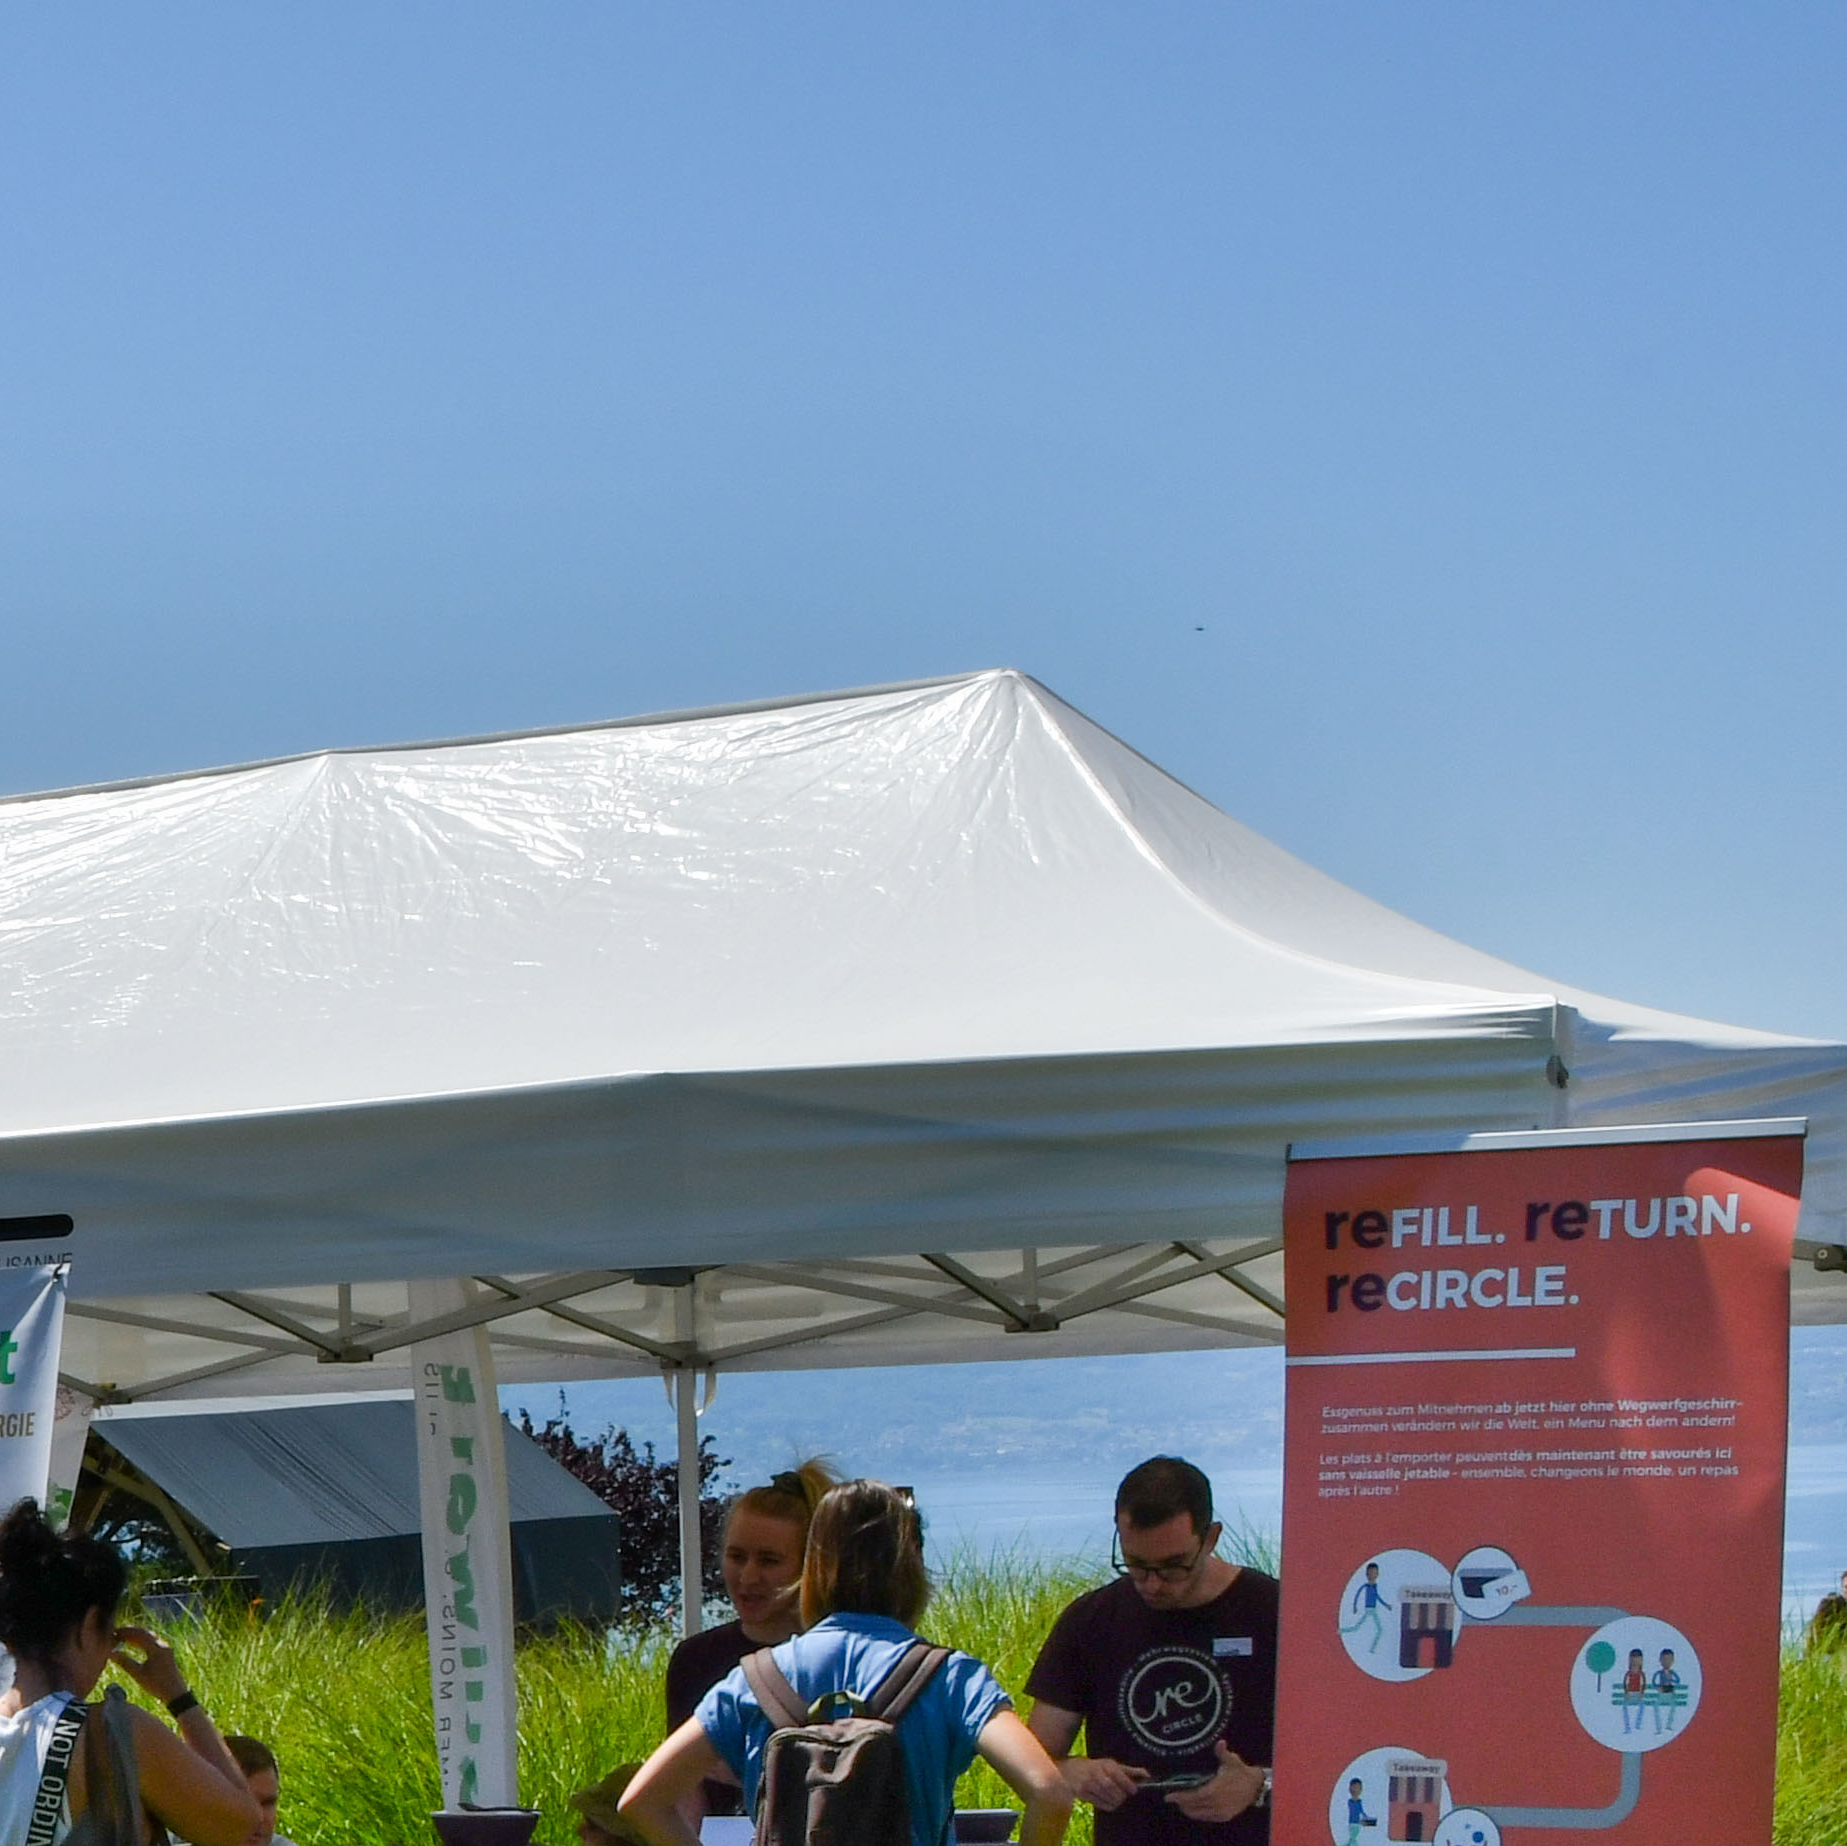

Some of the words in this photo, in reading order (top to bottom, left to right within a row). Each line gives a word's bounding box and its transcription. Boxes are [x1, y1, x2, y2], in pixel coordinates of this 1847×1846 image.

[1324, 1204, 1506, 1250] reFILL.
[1525, 1193, 1752, 1242] reTURN.
[1326, 1265, 1580, 1313] reCIRCLE.
[1322, 1406, 1383, 1419] Essgenuss
[1386, 1407, 1414, 1416] zum
[1418, 1404, 1492, 1415] Mitnehmen
[1495, 1403, 1510, 1414] ab
[1514, 1402, 1545, 1416] jetzt
[1550, 1401, 1575, 1412] hier
[1580, 1400, 1614, 1411] ohne
[1321, 1423, 1388, 1434] zusammen
[1392, 1420, 1455, 1432] verändern
[1459, 1420, 1479, 1431] wir
[1484, 1419, 1503, 1430] die
[1544, 1418, 1564, 1429] ein
[1568, 1417, 1605, 1428] Menu
[1609, 1416, 1643, 1428] nach
[1646, 1415, 1678, 1426] dem
[1319, 1454, 1339, 1465] Les
[1341, 1453, 1371, 1467] plats
[1456, 1452, 1508, 1465] peuvent
[1508, 1450, 1532, 1462] dès
[1536, 1449, 1615, 1461] maintenant
[1619, 1448, 1647, 1460] être
[1650, 1447, 1711, 1460] savourés
[1715, 1447, 1732, 1459] ici
[1318, 1470, 1346, 1481] sans
[1349, 1468, 1400, 1480] vaisselle
[1404, 1466, 1450, 1481] jetable
[1531, 1466, 1604, 1480] changeons
[1607, 1465, 1619, 1477] le
[1678, 1466, 1697, 1477] un
[1700, 1466, 1739, 1479] repas
[1318, 1485, 1350, 1498] après
[1163, 1714, 1202, 1734] CIRCLE
[47, 1717, 81, 1769] NOT
[1393, 1763, 1440, 1775] Takeaway
